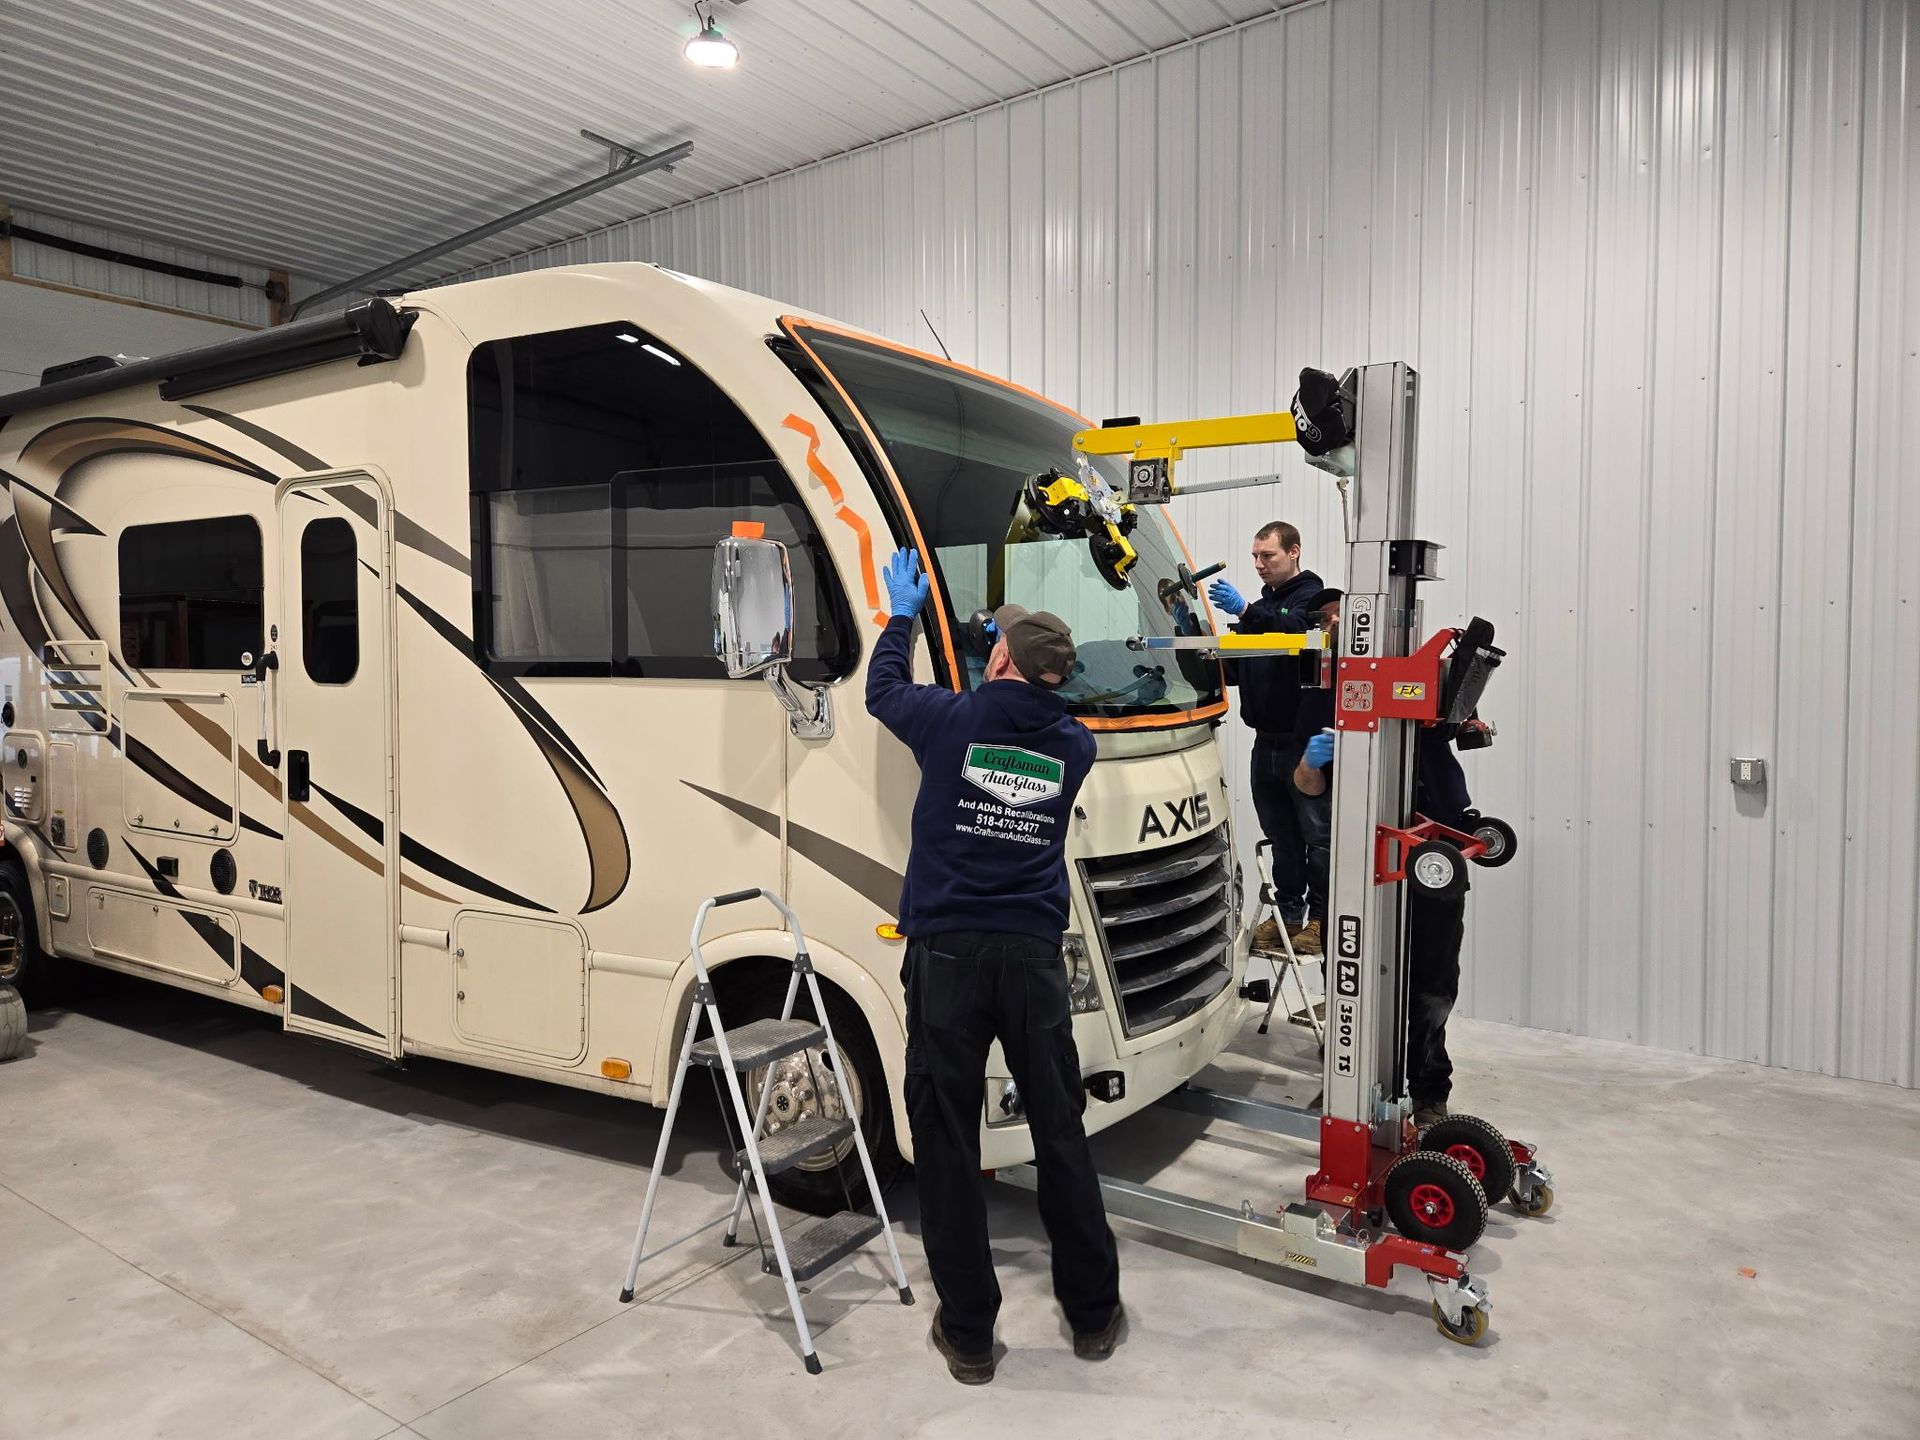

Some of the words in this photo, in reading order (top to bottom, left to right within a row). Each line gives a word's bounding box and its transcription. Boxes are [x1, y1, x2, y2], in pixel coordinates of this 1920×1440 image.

[983, 751, 1050, 775] Craftsman
[982, 771, 1046, 793] AutoGlass
[958, 798, 976, 810] And
[977, 802, 1003, 814] ADAS
[1004, 807, 1055, 824] Recalibrations
[976, 813, 1040, 833] 518-470-2477
[1138, 790, 1212, 844] AXIS
[1342, 920, 1357, 954] EVO
[1340, 964, 1356, 993] 2.0
[1339, 1004, 1353, 1047] 3500
[1338, 1055, 1351, 1073] TS
